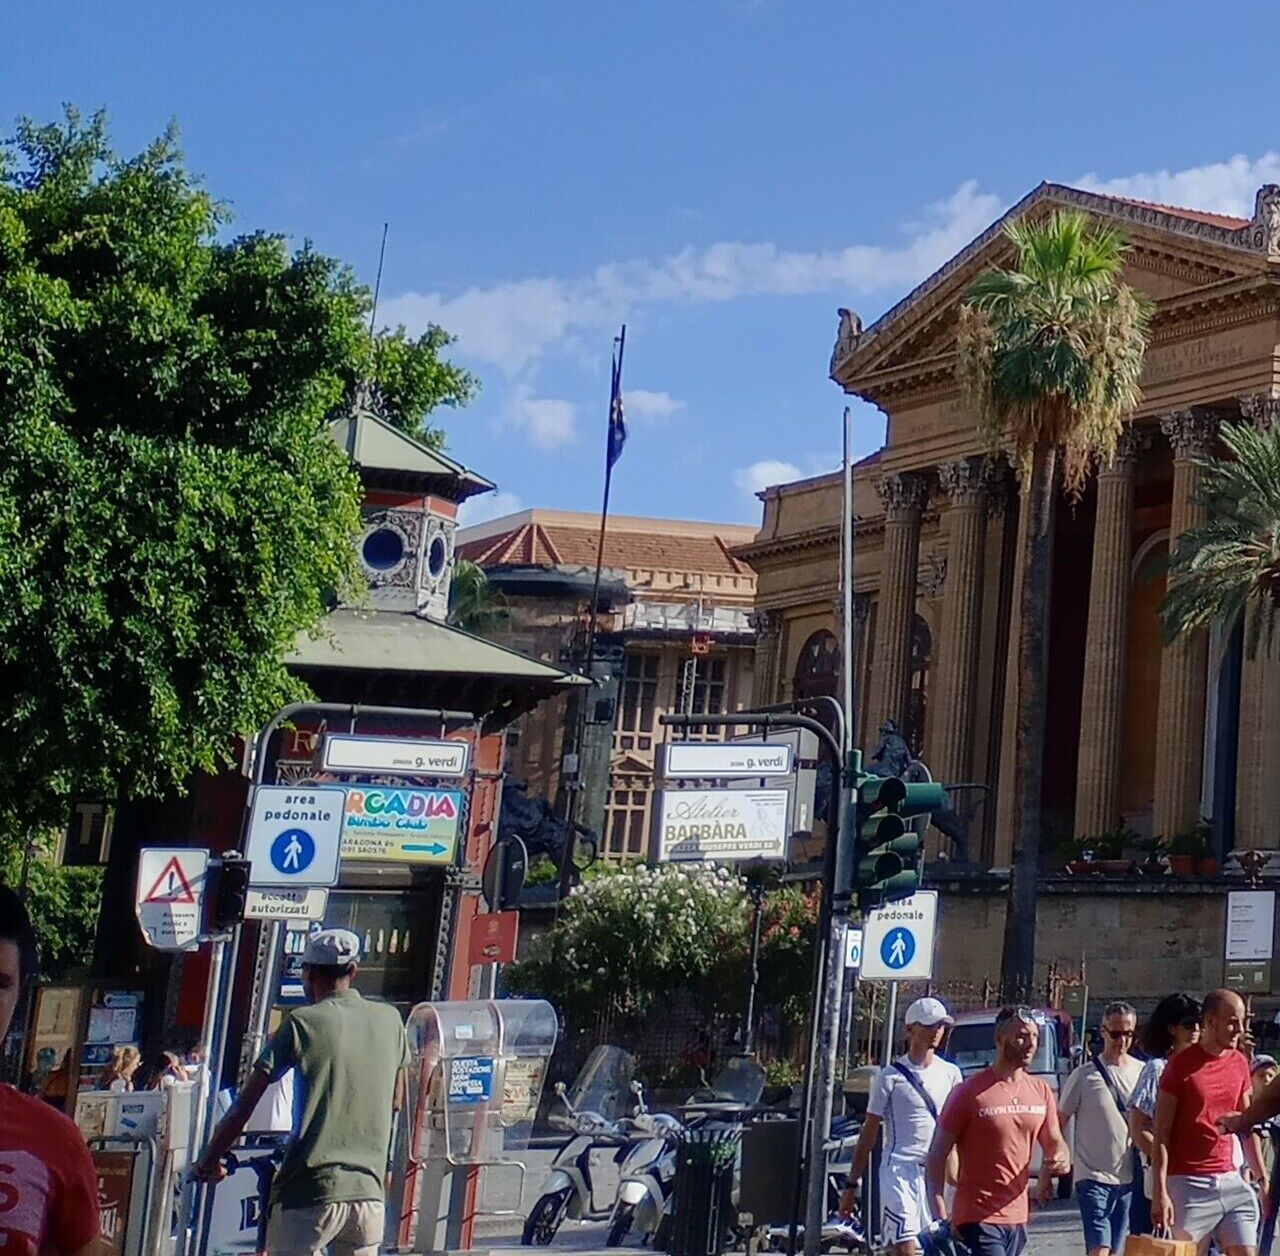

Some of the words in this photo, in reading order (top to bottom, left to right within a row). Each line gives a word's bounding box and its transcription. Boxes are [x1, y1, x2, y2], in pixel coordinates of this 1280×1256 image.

[428, 756, 457, 767] verdi
[758, 757, 783, 767] verdi
[285, 795, 316, 805] area
[345, 791, 456, 818] RCADIA
[667, 794, 741, 820] Atelier
[264, 809, 331, 822] pedonale
[250, 903, 310, 915] autorizzati
[877, 910, 924, 921] pedonale
[978, 1105, 1007, 1118] CALVIN
